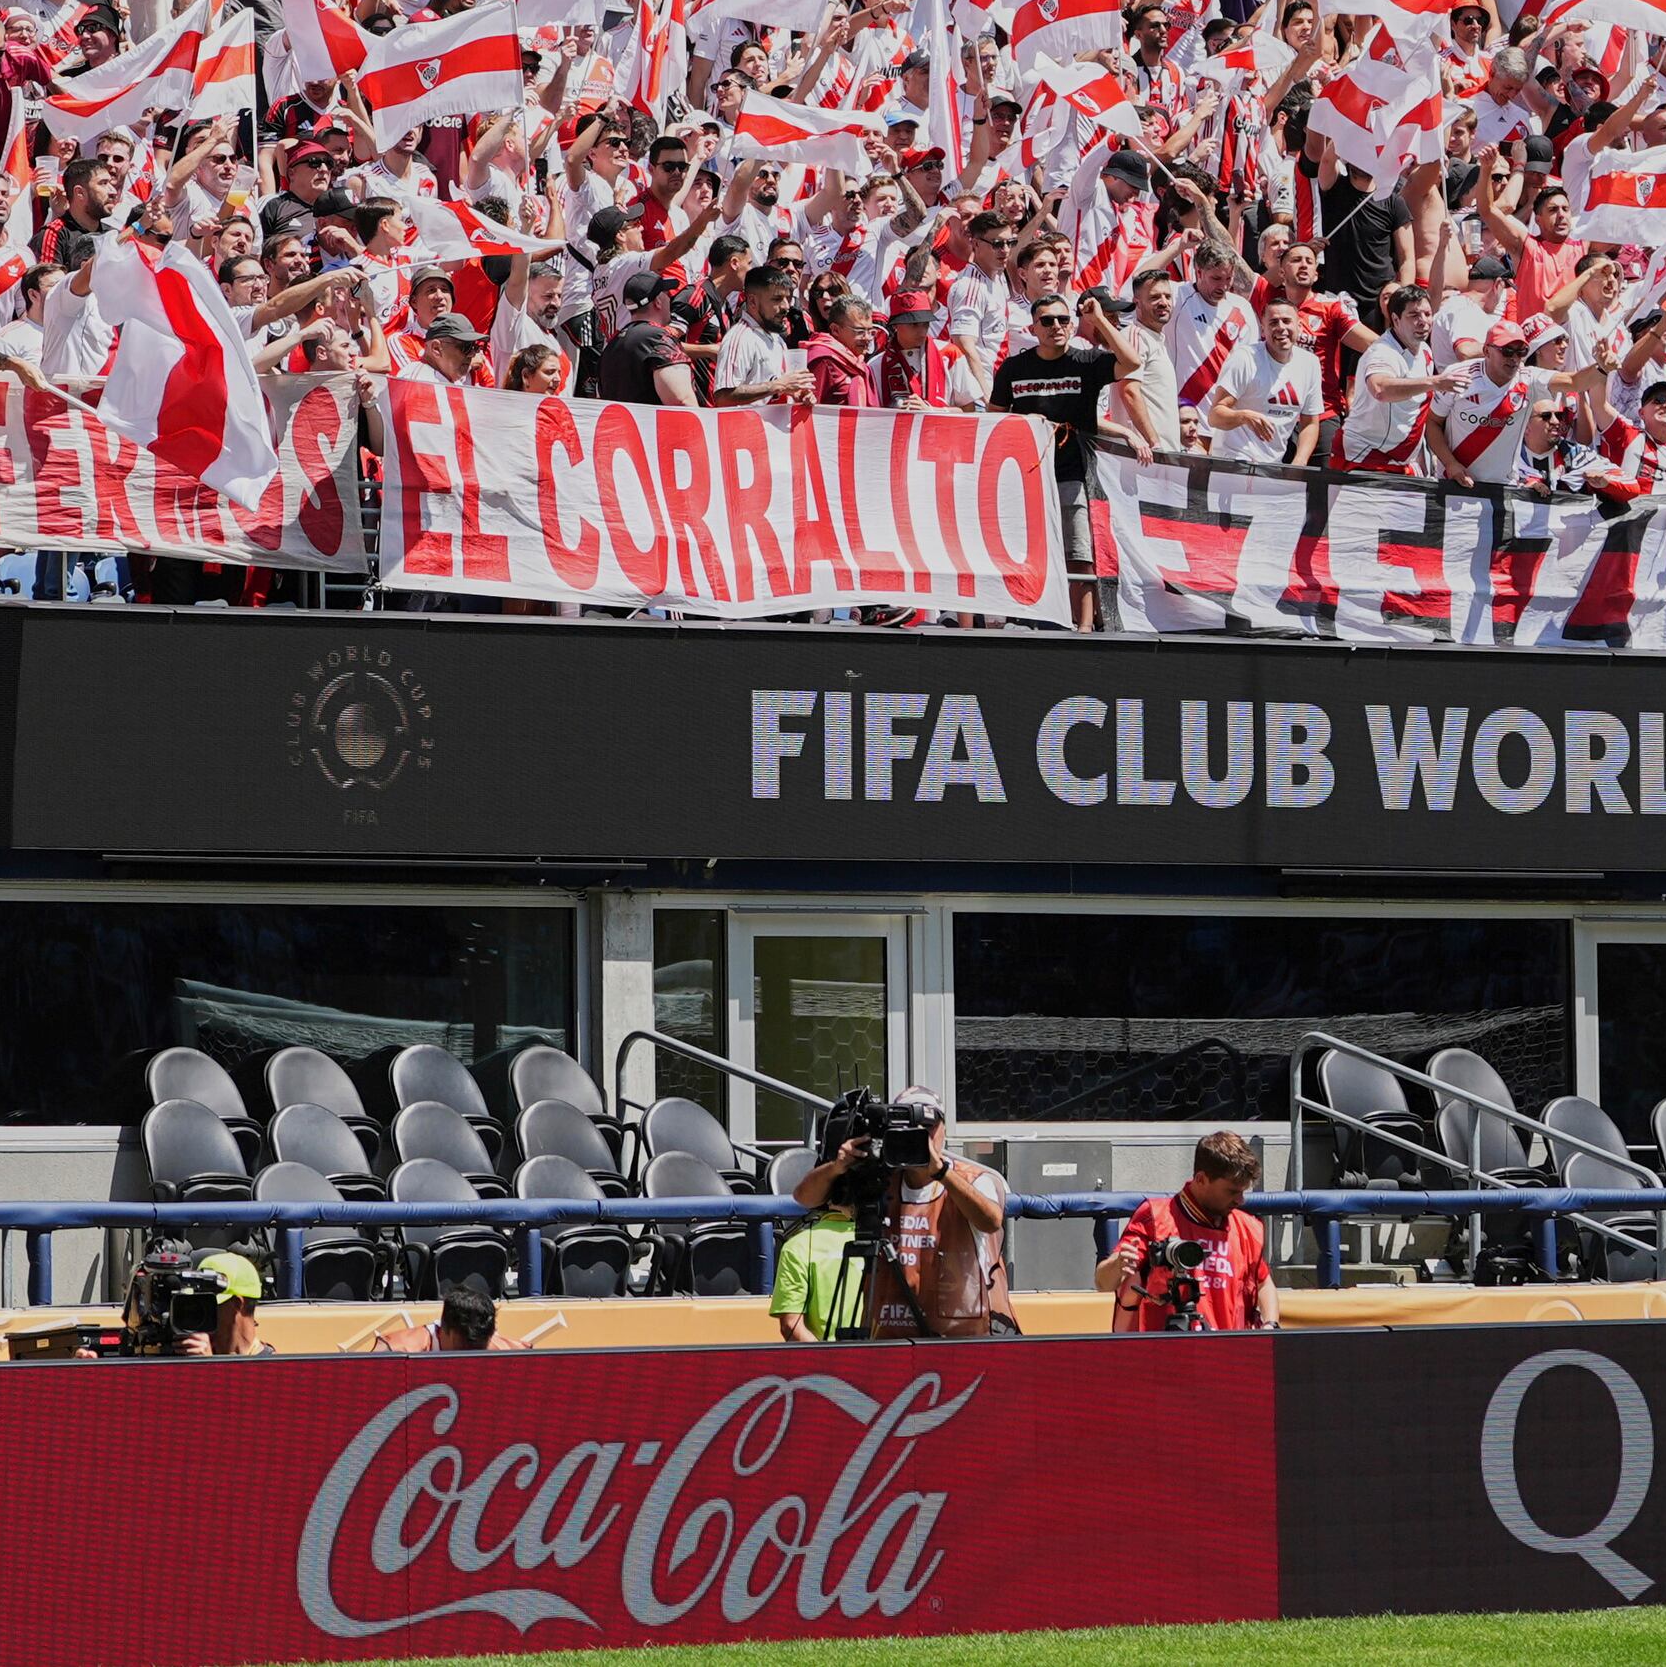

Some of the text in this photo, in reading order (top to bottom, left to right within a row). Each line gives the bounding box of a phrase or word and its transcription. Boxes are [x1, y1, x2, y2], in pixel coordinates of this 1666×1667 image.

[1459, 412, 1515, 427] codere
[392, 378, 1049, 604] EL CORRALITO
[286, 692, 307, 767] CLUB
[305, 644, 392, 682] WORLD
[400, 668, 433, 719] CUP
[750, 689, 1009, 804] FIFA
[1035, 694, 1335, 809] CLUB
[296, 1370, 987, 1639] Coca-Cola
